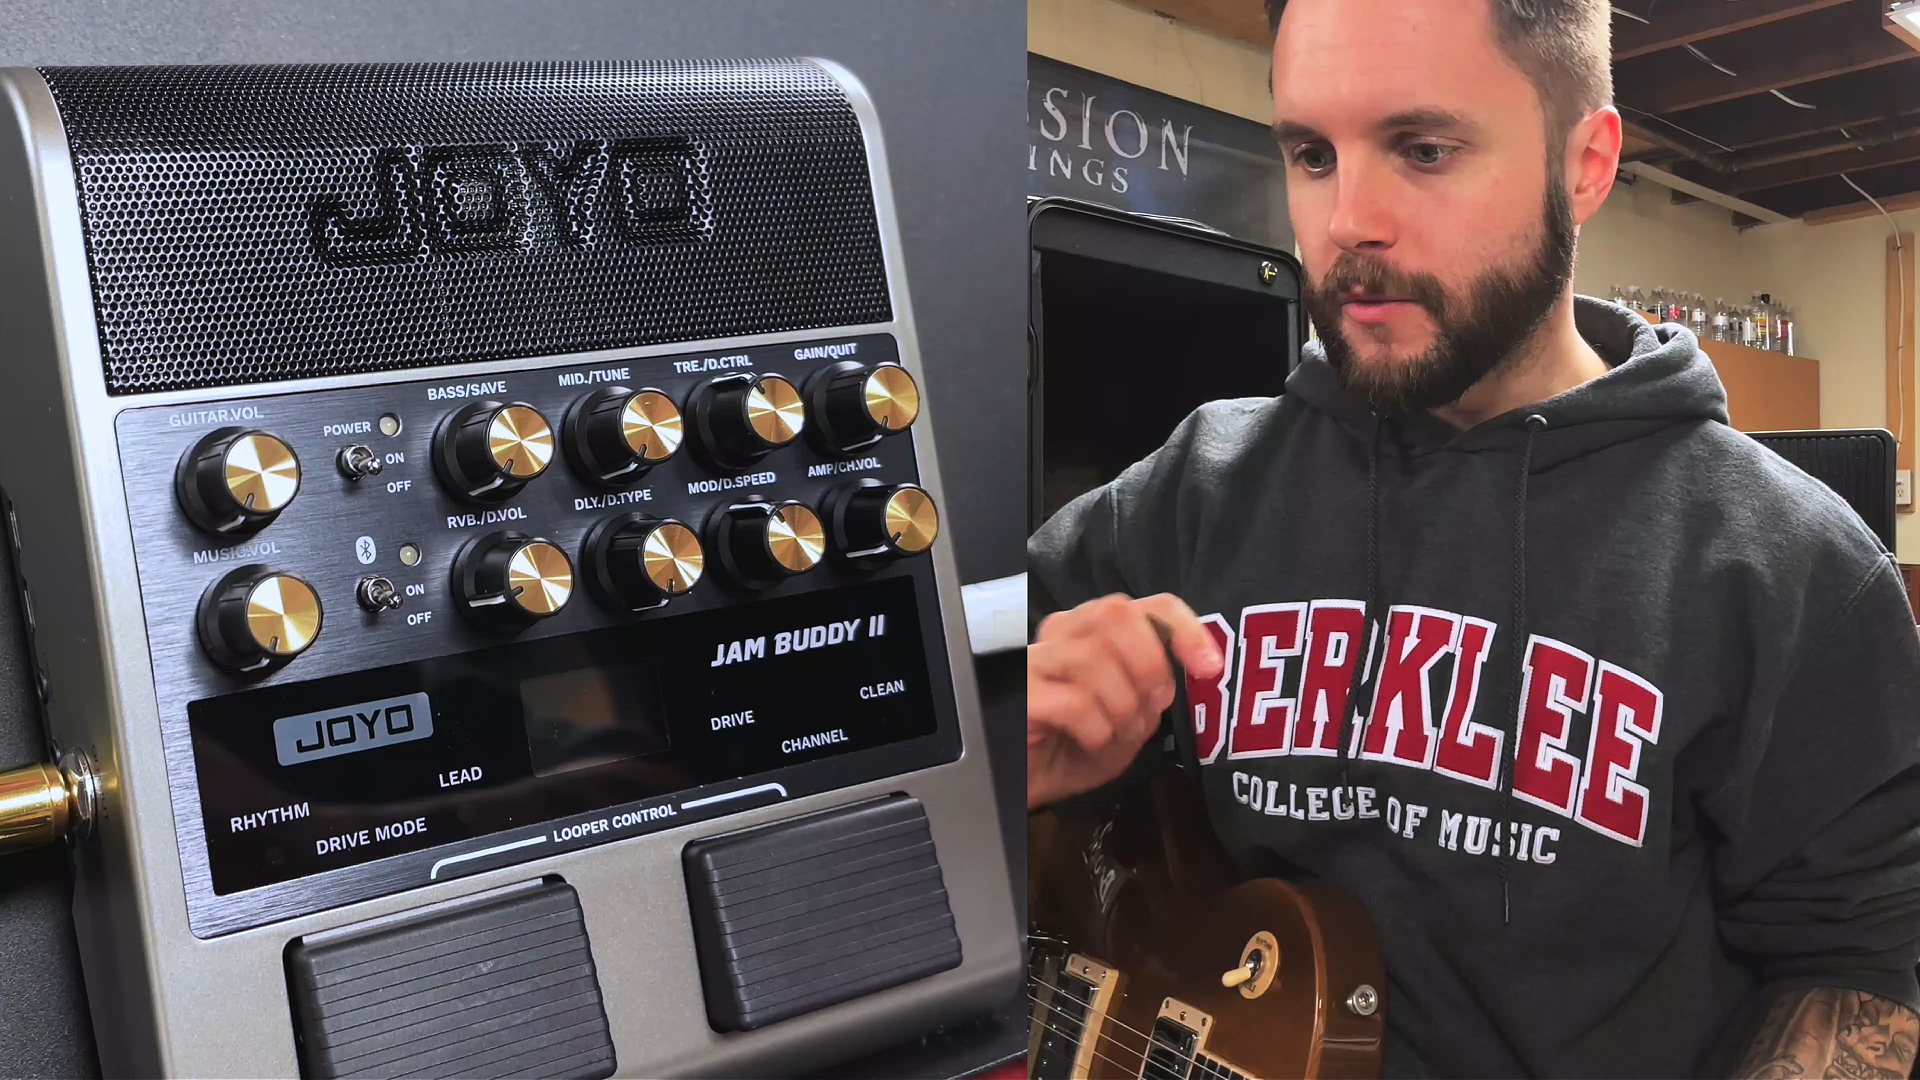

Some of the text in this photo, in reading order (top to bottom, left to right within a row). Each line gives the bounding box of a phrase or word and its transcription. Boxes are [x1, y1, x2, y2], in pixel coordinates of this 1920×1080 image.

[1027, 80, 1194, 178] SION
[312, 137, 712, 267] JOYO
[794, 343, 857, 361] GAIN/QUIT
[673, 355, 753, 374] TRE./D.CTRL
[558, 367, 630, 387] MID./TUNE
[427, 380, 507, 401] BASS/SAVE
[168, 405, 264, 428] GUITAR.VOL
[323, 420, 371, 436] POWER
[385, 452, 404, 465] ON
[808, 456, 881, 478] AMP/CH.VOL
[387, 480, 412, 494] OFF
[688, 472, 776, 494] MOD/D.SPEED
[574, 489, 652, 511] DLY./D.TYPE
[447, 507, 527, 529] RVB./D.VOL
[194, 542, 281, 565] MUSIC.VOL
[406, 583, 425, 596] ON
[407, 612, 432, 626] OFF
[711, 614, 886, 667] JAM BUDDY II
[860, 679, 904, 699] CLEAN
[296, 704, 414, 753] JOYO
[711, 710, 755, 731] DRIVE
[1184, 599, 1663, 847] BERKLEE
[781, 728, 848, 754] CHANNEL
[439, 766, 483, 788] LEAD
[231, 802, 310, 833] RHYTHM
[553, 803, 677, 842] LOOPER CONTROL
[1232, 771, 1561, 864] COLLEGE OF MUSIC
[316, 817, 427, 856] DRIVE MODE
